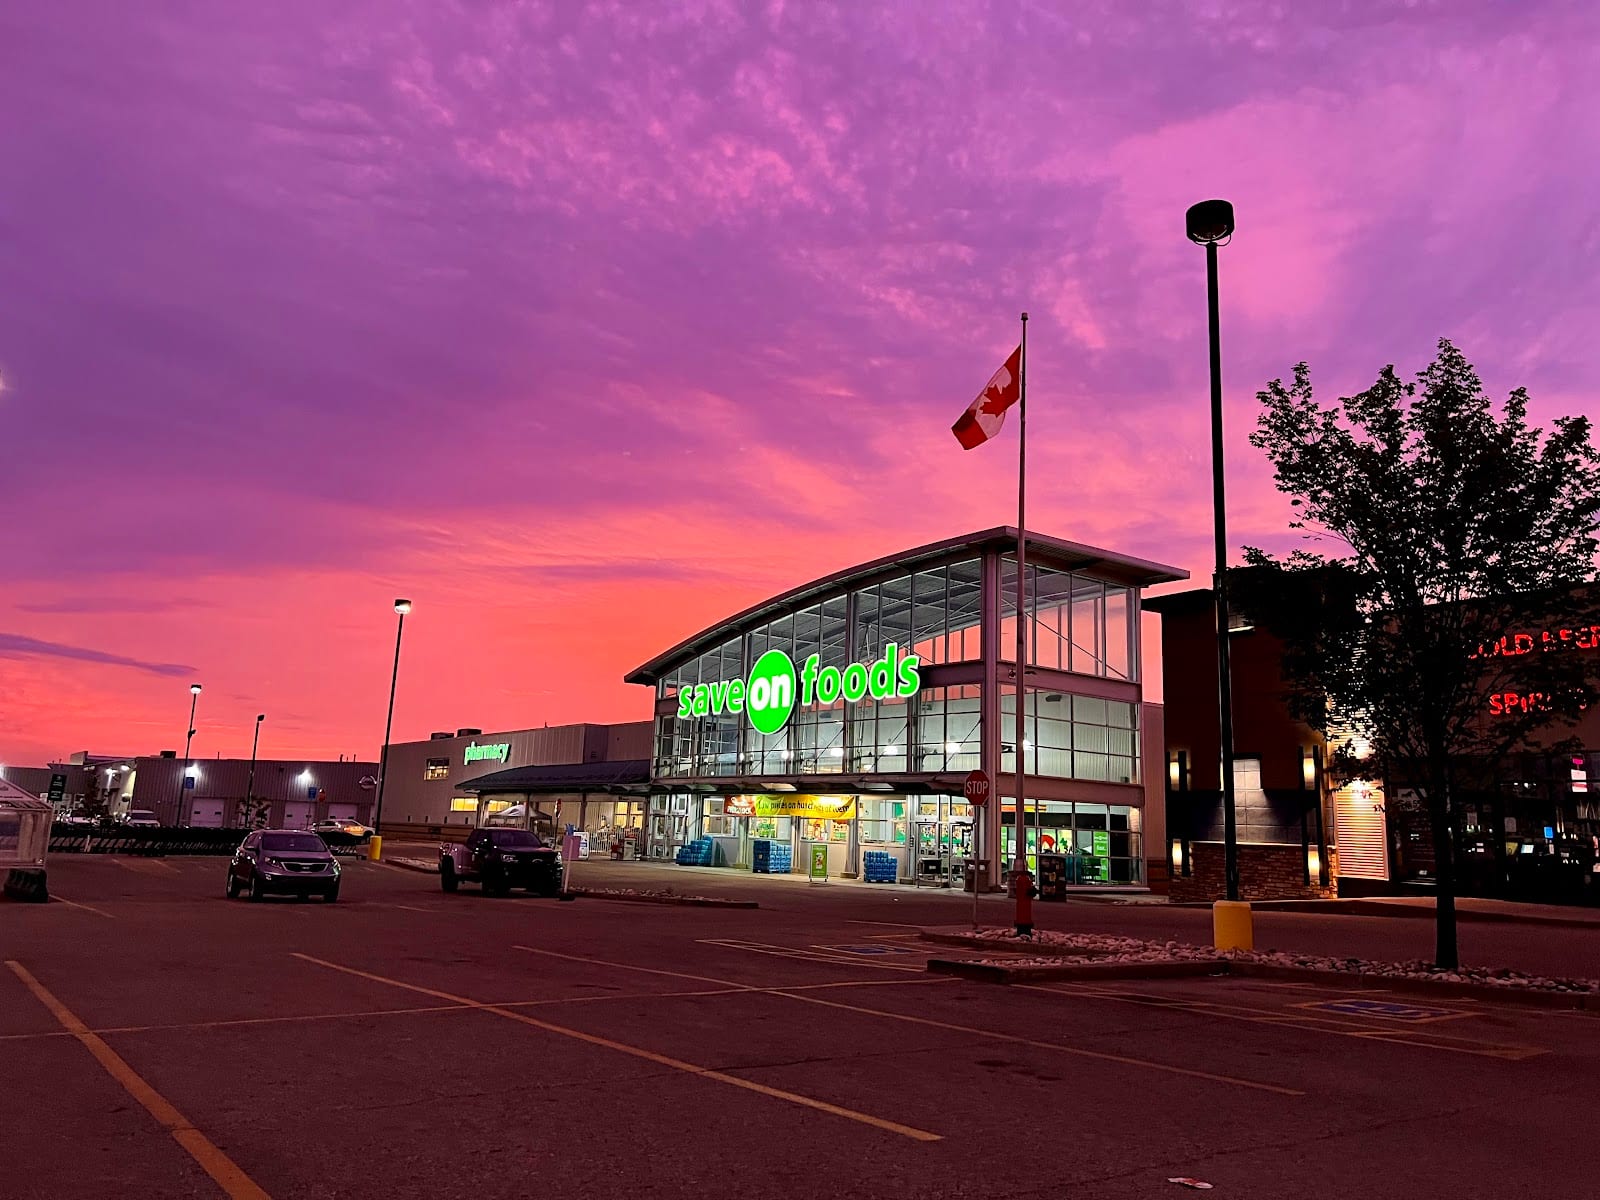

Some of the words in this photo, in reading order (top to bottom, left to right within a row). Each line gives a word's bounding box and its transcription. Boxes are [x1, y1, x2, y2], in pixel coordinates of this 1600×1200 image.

[677, 678, 745, 718] save
[751, 673, 791, 711] on
[801, 643, 920, 706] foods
[464, 741, 509, 765] pharmacy
[966, 781, 989, 795] STOP
